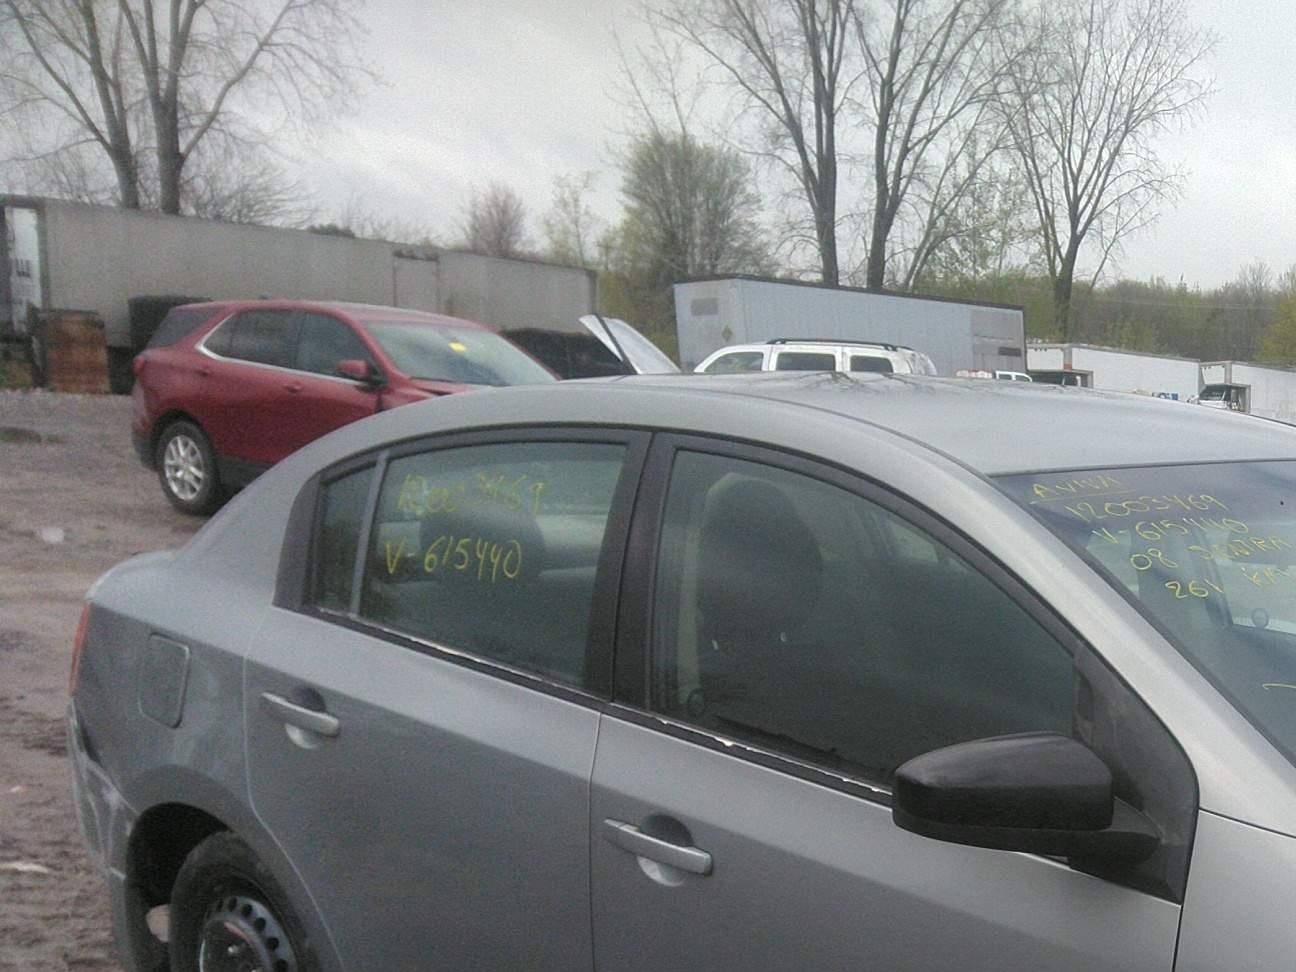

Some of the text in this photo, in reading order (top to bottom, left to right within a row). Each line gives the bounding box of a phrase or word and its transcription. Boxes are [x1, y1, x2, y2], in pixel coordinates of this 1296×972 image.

[1064, 494, 1229, 522] 12003469
[1130, 547, 1179, 570] 08
[1165, 578, 1227, 599] 261
